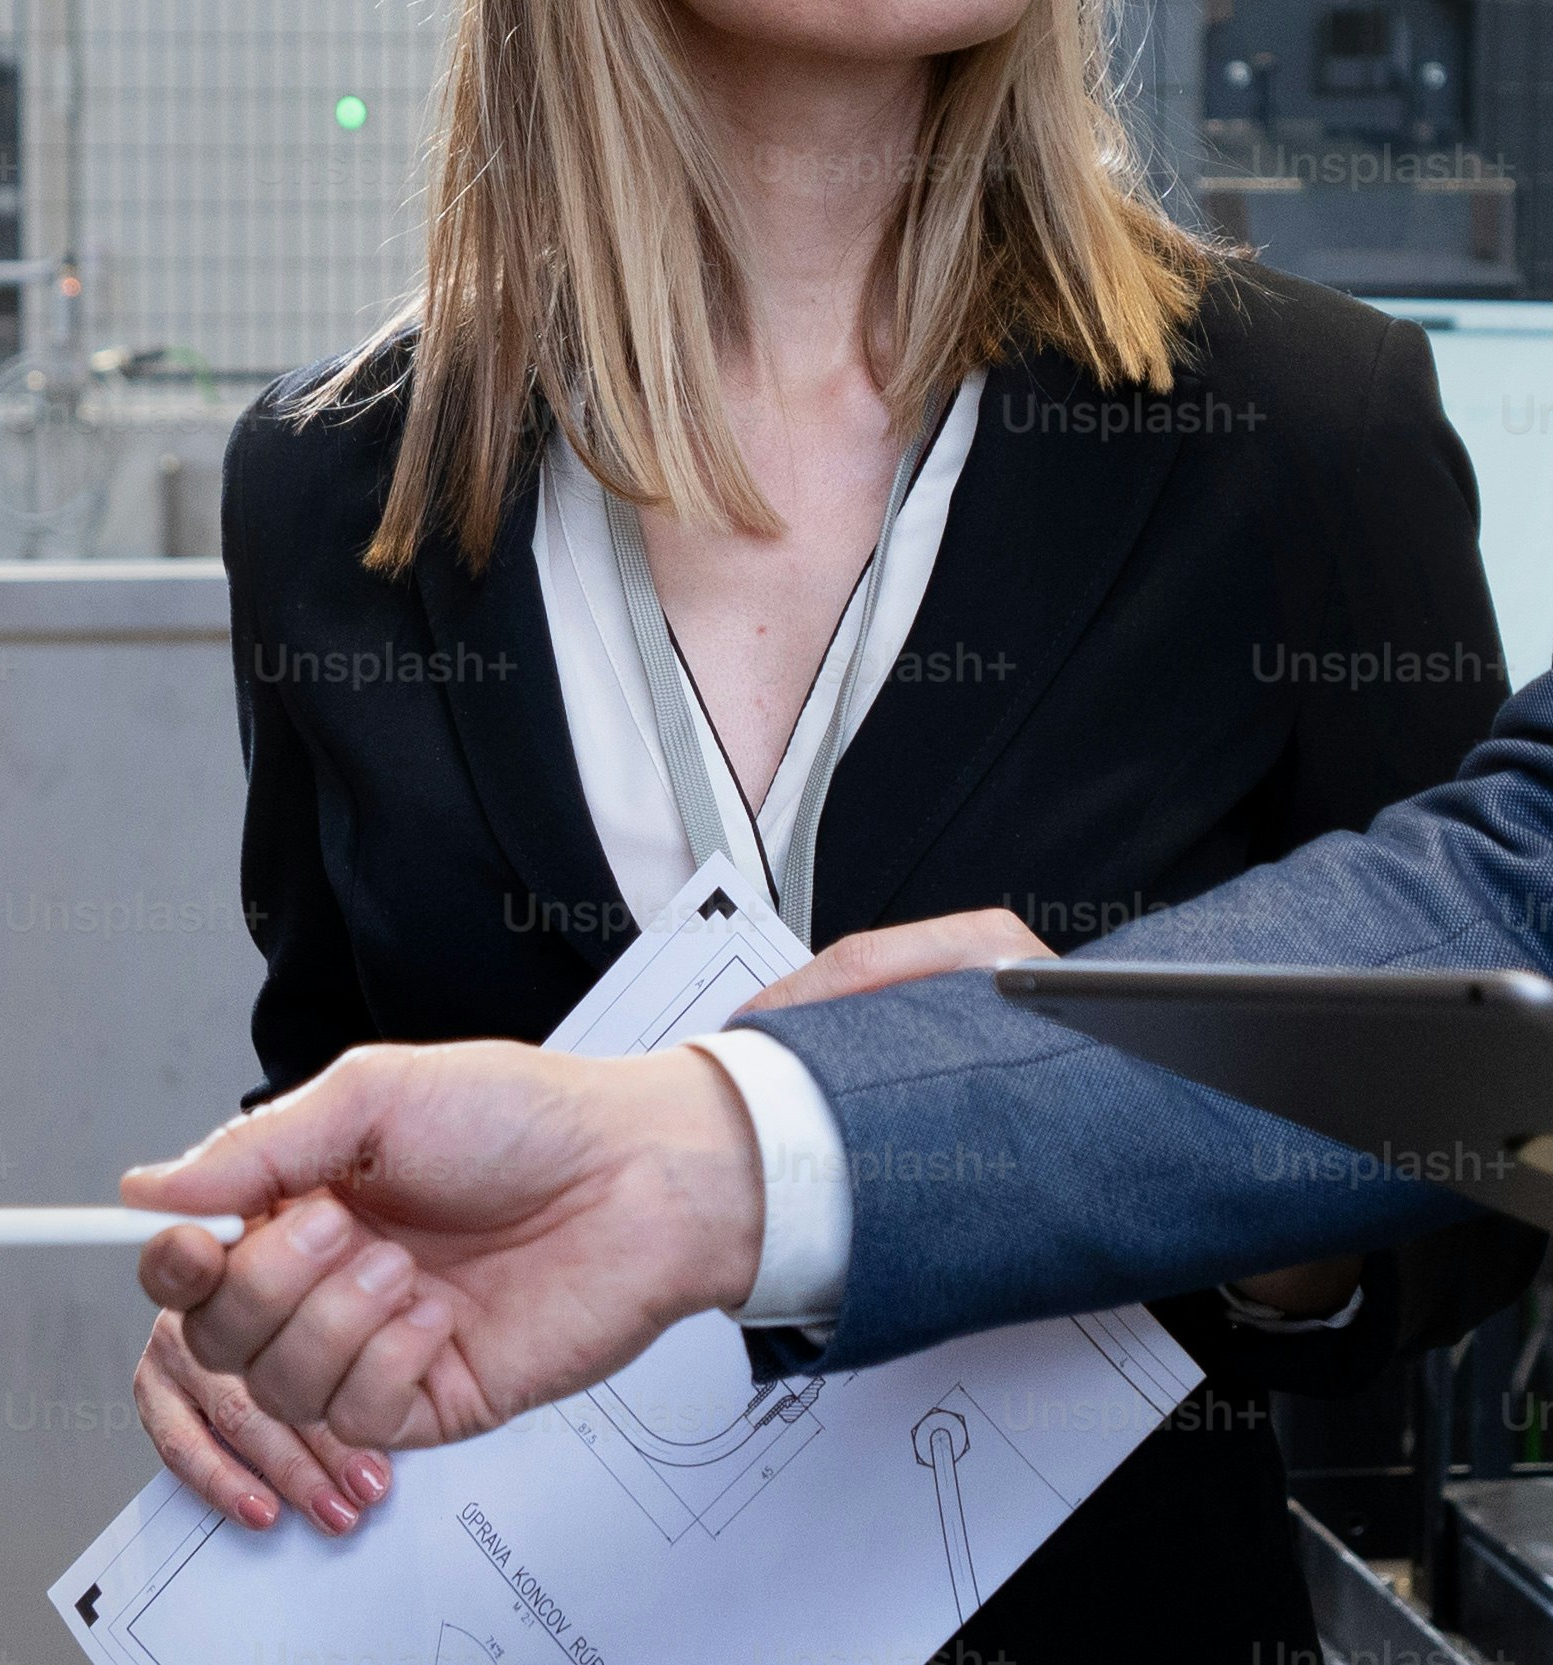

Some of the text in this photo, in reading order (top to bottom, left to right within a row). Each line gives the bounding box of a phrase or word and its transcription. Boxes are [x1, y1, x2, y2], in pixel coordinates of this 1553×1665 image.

[760, 1465, 775, 1481] 45
[461, 1502, 512, 1568] ÚPRAVA
[511, 1565, 572, 1635] KONCOV
